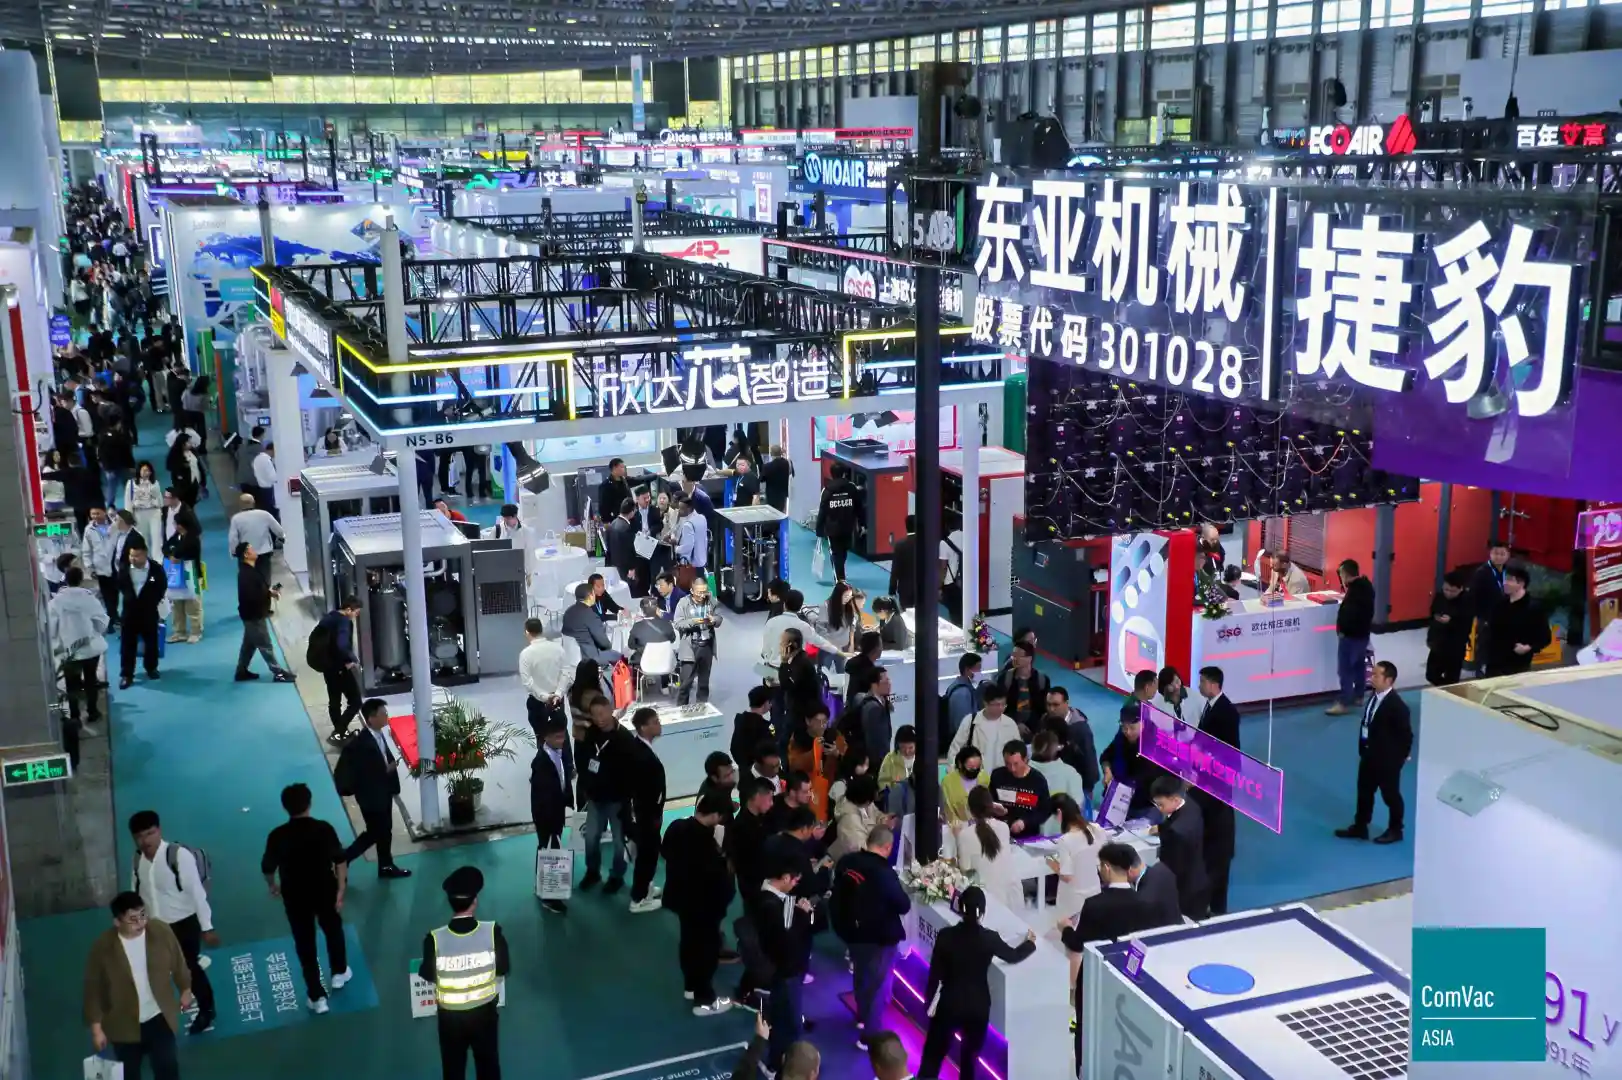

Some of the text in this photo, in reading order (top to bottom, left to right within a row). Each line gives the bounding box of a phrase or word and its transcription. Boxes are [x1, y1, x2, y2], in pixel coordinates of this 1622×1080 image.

[1309, 123, 1384, 155] ECOAIR
[822, 159, 865, 188] MOAIR
[974, 172, 1572, 417] 东亚机械 捷豹
[971, 294, 1244, 399] 股票代码 301028
[597, 343, 830, 418] 欣达芯智造
[405, 432, 454, 448] N5-B6
[230, 952, 265, 1023] 上海国际压缩机
[264, 951, 300, 1013] 及设备展览会
